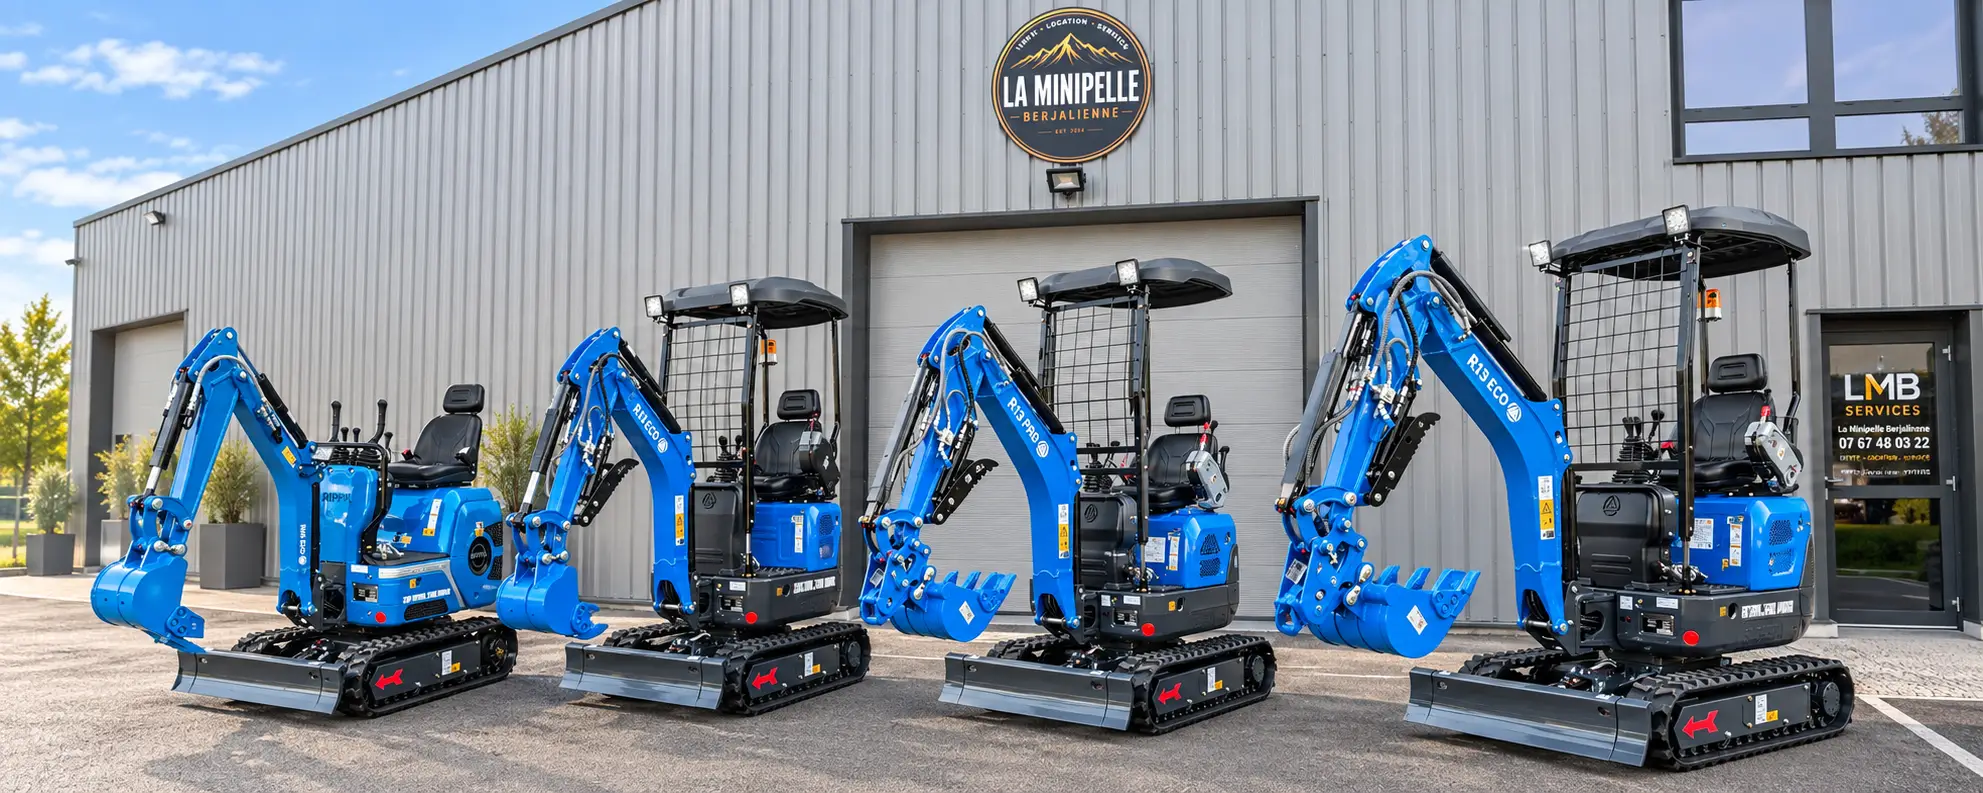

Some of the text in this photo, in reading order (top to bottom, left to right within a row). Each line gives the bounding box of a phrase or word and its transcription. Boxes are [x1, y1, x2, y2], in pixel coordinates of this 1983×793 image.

[1046, 18, 1088, 30] LOCATION
[1003, 69, 1140, 108] LA MINIPELLE
[1023, 106, 1119, 122] BERJALIENNE
[1466, 353, 1509, 406] R13 ECO
[1844, 373, 1921, 401] LMB
[1007, 396, 1025, 422] R13
[1845, 404, 1921, 417] SERVICES
[1839, 437, 1930, 449] 07 67 48 03 22
